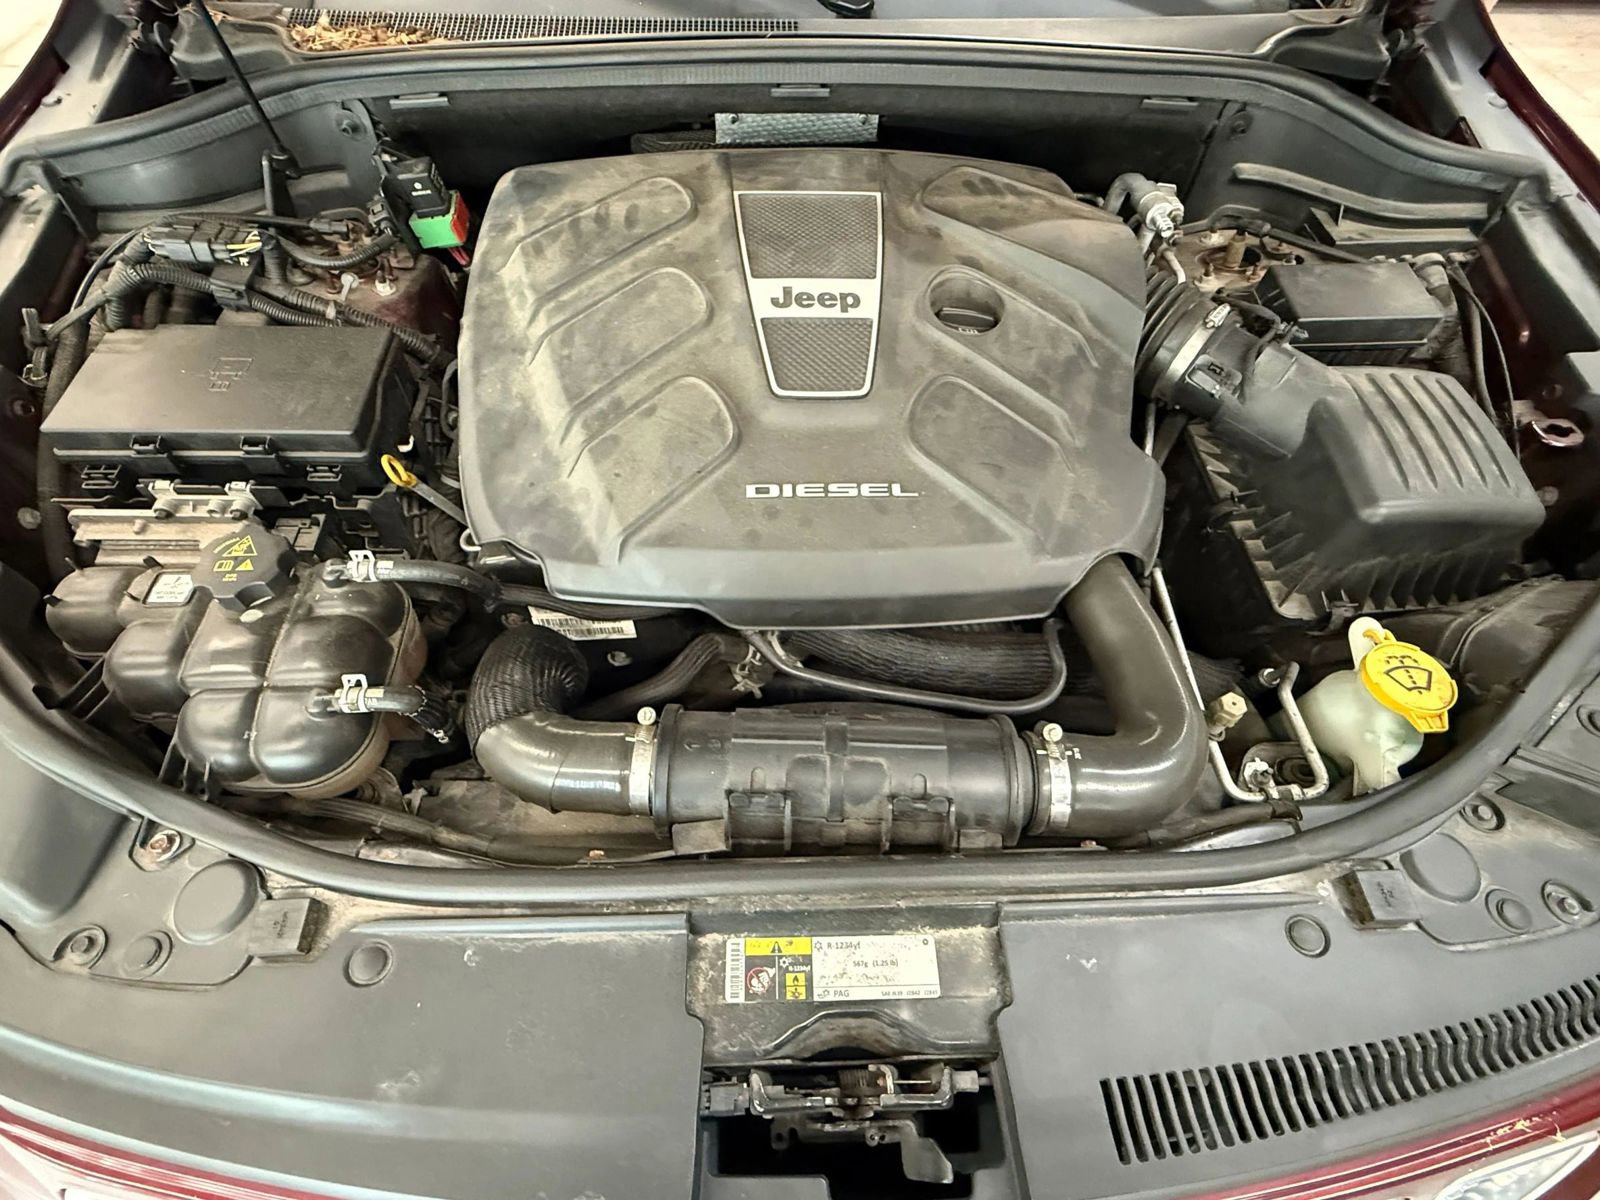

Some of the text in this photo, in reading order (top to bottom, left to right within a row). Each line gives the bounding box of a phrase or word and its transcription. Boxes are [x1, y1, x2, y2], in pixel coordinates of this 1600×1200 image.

[770, 286, 861, 313] Jeep
[745, 483, 919, 498] DIESEL
[833, 989, 850, 998] PAG
